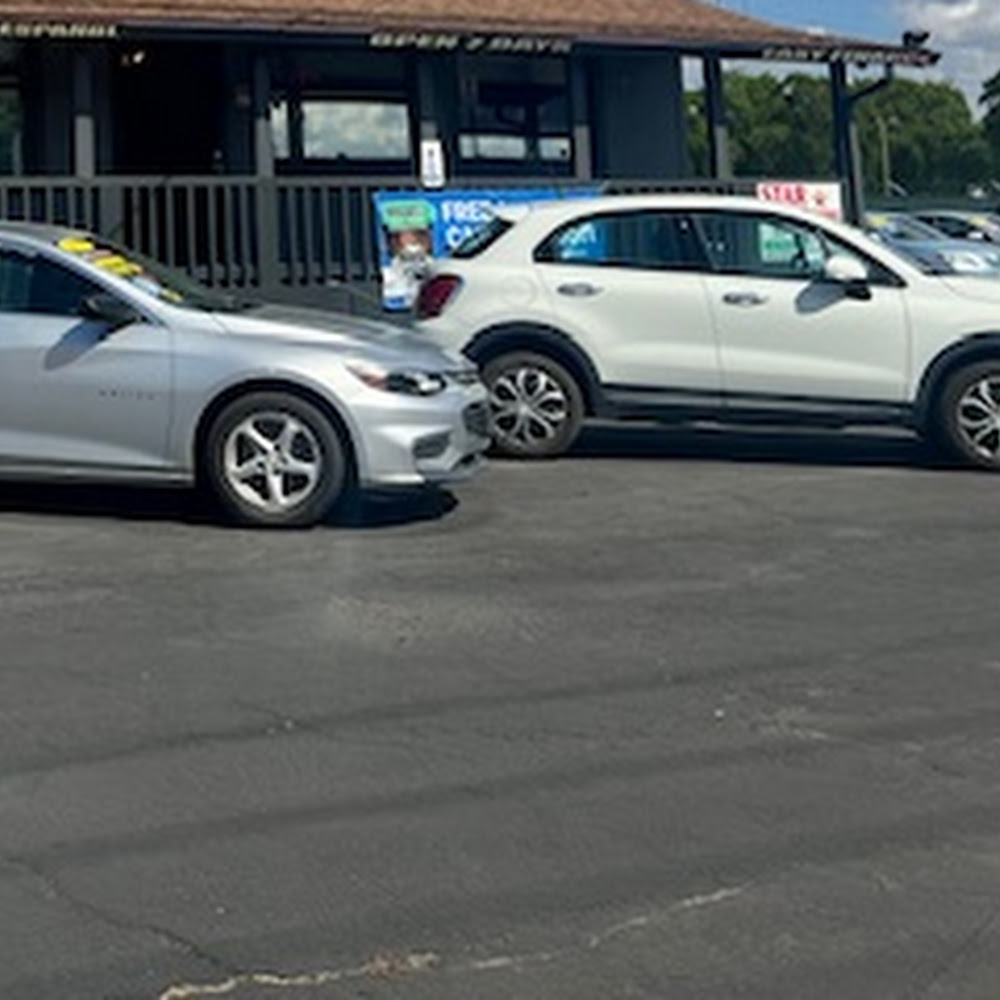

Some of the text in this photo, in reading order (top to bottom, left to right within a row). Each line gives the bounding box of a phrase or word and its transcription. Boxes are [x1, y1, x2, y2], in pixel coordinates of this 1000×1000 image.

[369, 32, 572, 53] OPEN 7 DAYS
